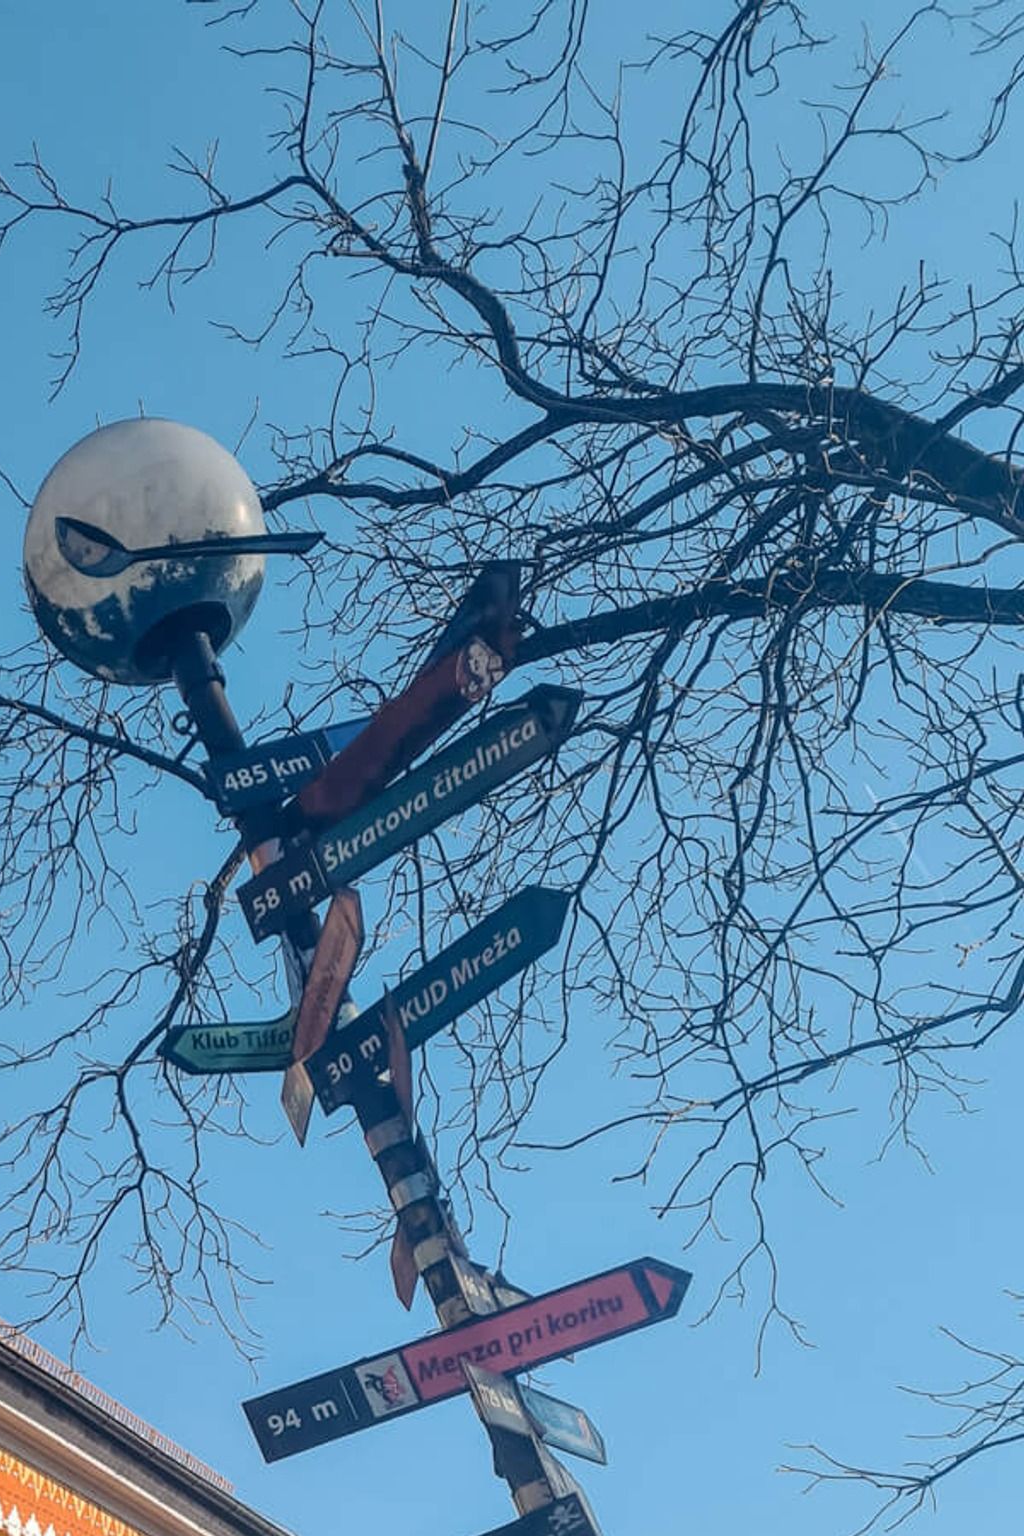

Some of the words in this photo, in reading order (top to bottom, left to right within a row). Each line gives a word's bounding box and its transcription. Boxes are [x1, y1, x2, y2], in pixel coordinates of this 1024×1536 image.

[224, 763, 268, 791] 485
[270, 754, 312, 778] km
[251, 886, 281, 920] 58
[288, 870, 313, 896] m
[323, 789, 429, 873] Škratova
[432, 717, 538, 798] čitalnica
[191, 1031, 239, 1051] Klub
[327, 1052, 353, 1085] 30
[359, 1033, 382, 1060] m
[399, 976, 449, 1029] KUD
[451, 923, 523, 995] Mreža
[266, 1405, 302, 1438] 94
[311, 1395, 340, 1424] m
[416, 1333, 503, 1385] Menza
[507, 1318, 543, 1356] pri
[547, 1292, 624, 1336] koritu
